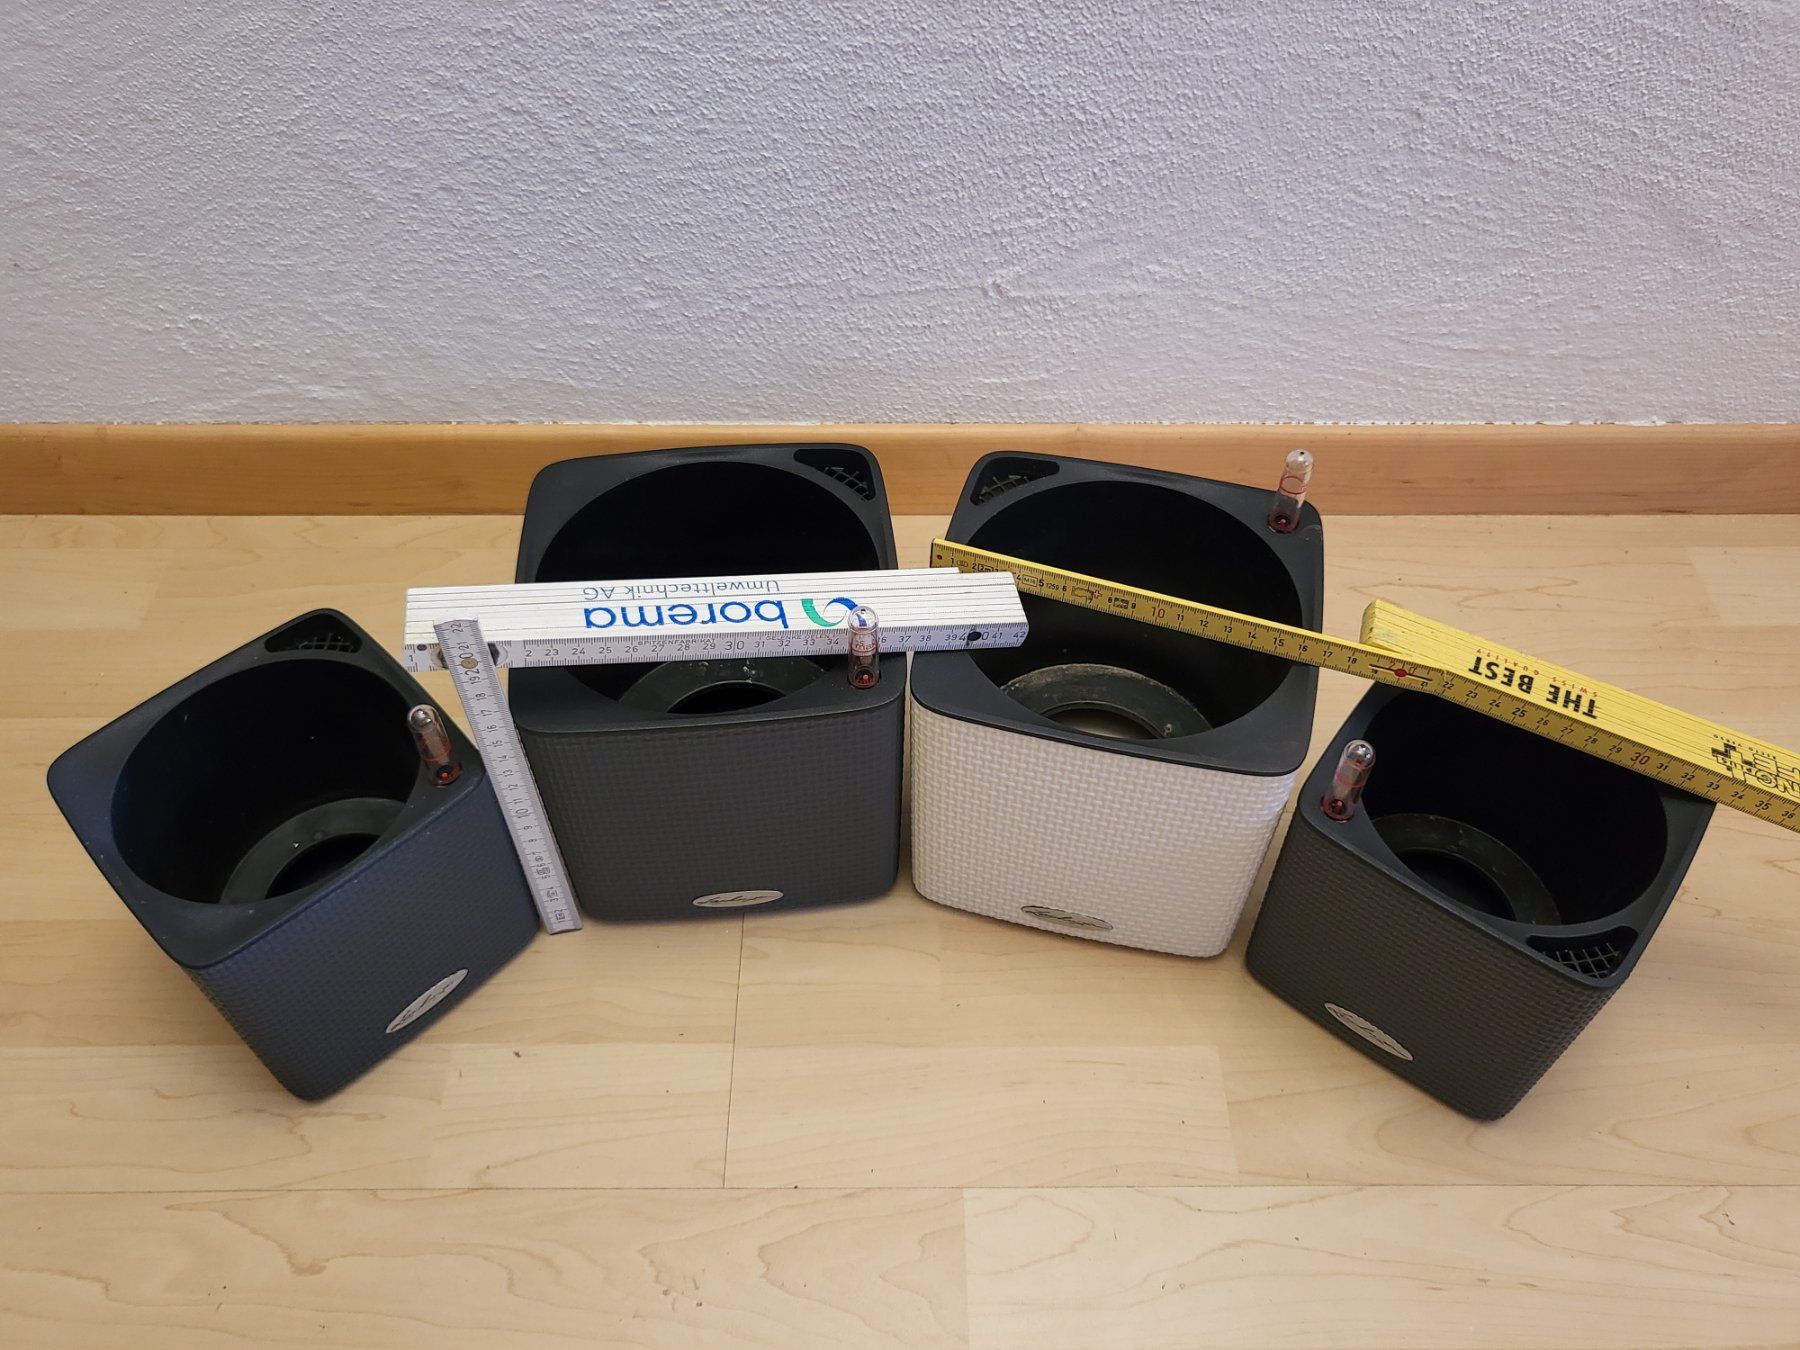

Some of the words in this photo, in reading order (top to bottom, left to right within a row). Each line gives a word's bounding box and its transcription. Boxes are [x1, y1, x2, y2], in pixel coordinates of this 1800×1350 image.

[583, 587, 615, 600] AG
[625, 579, 780, 599] Umwelttechnik
[584, 600, 789, 629] borema
[450, 623, 464, 633] 22
[457, 641, 469, 650] 21
[545, 648, 559, 656] 23
[572, 647, 586, 655] 24
[598, 646, 612, 654] 25
[625, 645, 639, 653] 26
[677, 643, 690, 651] 28
[703, 642, 716, 650] 29
[724, 640, 744, 650] 30
[469, 676, 481, 684] 19
[1468, 656, 1534, 694] BEST
[1552, 676, 1598, 698] SWISS
[475, 692, 486, 701] 18
[1039, 579, 1044, 587] 5
[1151, 606, 1165, 618] 10
[1176, 613, 1184, 621] 11
[1200, 619, 1209, 628] 12
[1223, 625, 1232, 633] 13
[1247, 631, 1257, 640] 14
[1273, 637, 1285, 647] 15
[1298, 644, 1308, 652] 16
[1322, 650, 1333, 658] 17
[1347, 656, 1357, 664] 18
[1442, 681, 1454, 690] 22
[1466, 690, 1478, 698] 23
[1489, 699, 1501, 708] 24
[1511, 707, 1527, 718] 25
[1536, 718, 1549, 726] 26
[1560, 726, 1574, 735] 27
[1584, 735, 1598, 744] 28
[1609, 744, 1622, 753] 29
[1630, 752, 1650, 765] 30
[1657, 762, 1668, 771] 31
[1681, 772, 1695, 781] 32
[1706, 781, 1719, 790] 33
[1731, 791, 1745, 800] 34
[1755, 800, 1771, 811] 35
[1781, 810, 1795, 819] 36
[1546, 683, 1597, 719] THE
[481, 709, 492, 717] 17
[487, 724, 497, 732] 16
[492, 739, 503, 748] 15
[498, 754, 508, 762] 14
[502, 769, 513, 777] 13
[508, 783, 518, 791] 12
[516, 808, 530, 819] 10
